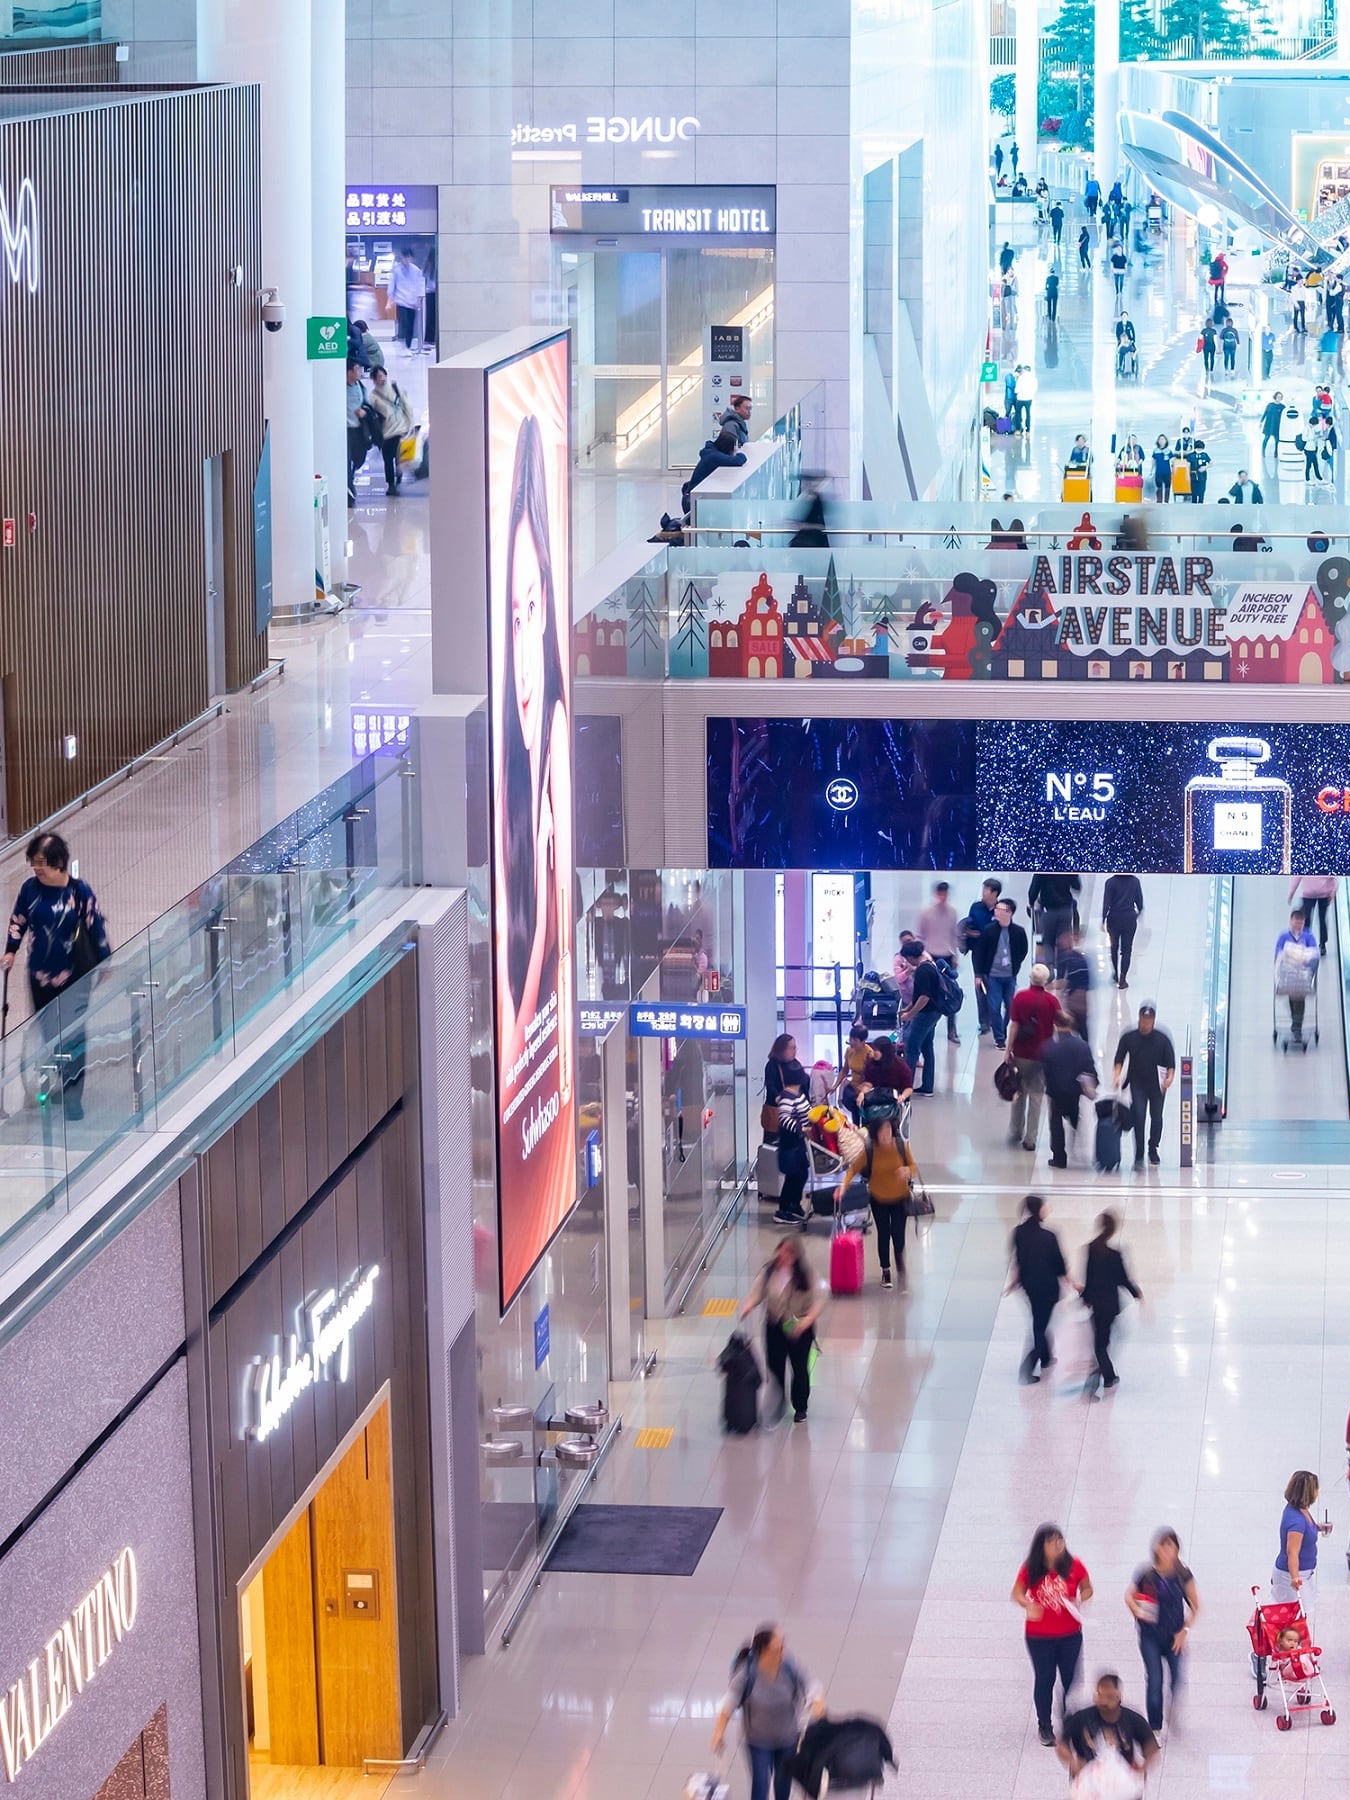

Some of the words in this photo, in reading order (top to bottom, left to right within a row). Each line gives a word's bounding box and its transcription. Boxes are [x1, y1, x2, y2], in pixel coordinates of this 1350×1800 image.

[642, 209, 712, 232] TRANSIT
[718, 210, 770, 232] HOTEL
[318, 342, 338, 350] AED
[1028, 554, 1215, 597] AIRSTAR
[1241, 592, 1293, 604] INCHEON
[1237, 603, 1288, 614] AIRPORT
[1056, 606, 1229, 647] AVENUE
[1229, 613, 1259, 624] DUTY
[1259, 613, 1290, 624] FREE
[751, 642, 779, 653] SALE
[679, 1014, 717, 1031] 화장실
[521, 1090, 561, 1161] Sulwhasoo
[0, 1546, 139, 1784] VALENTINO
